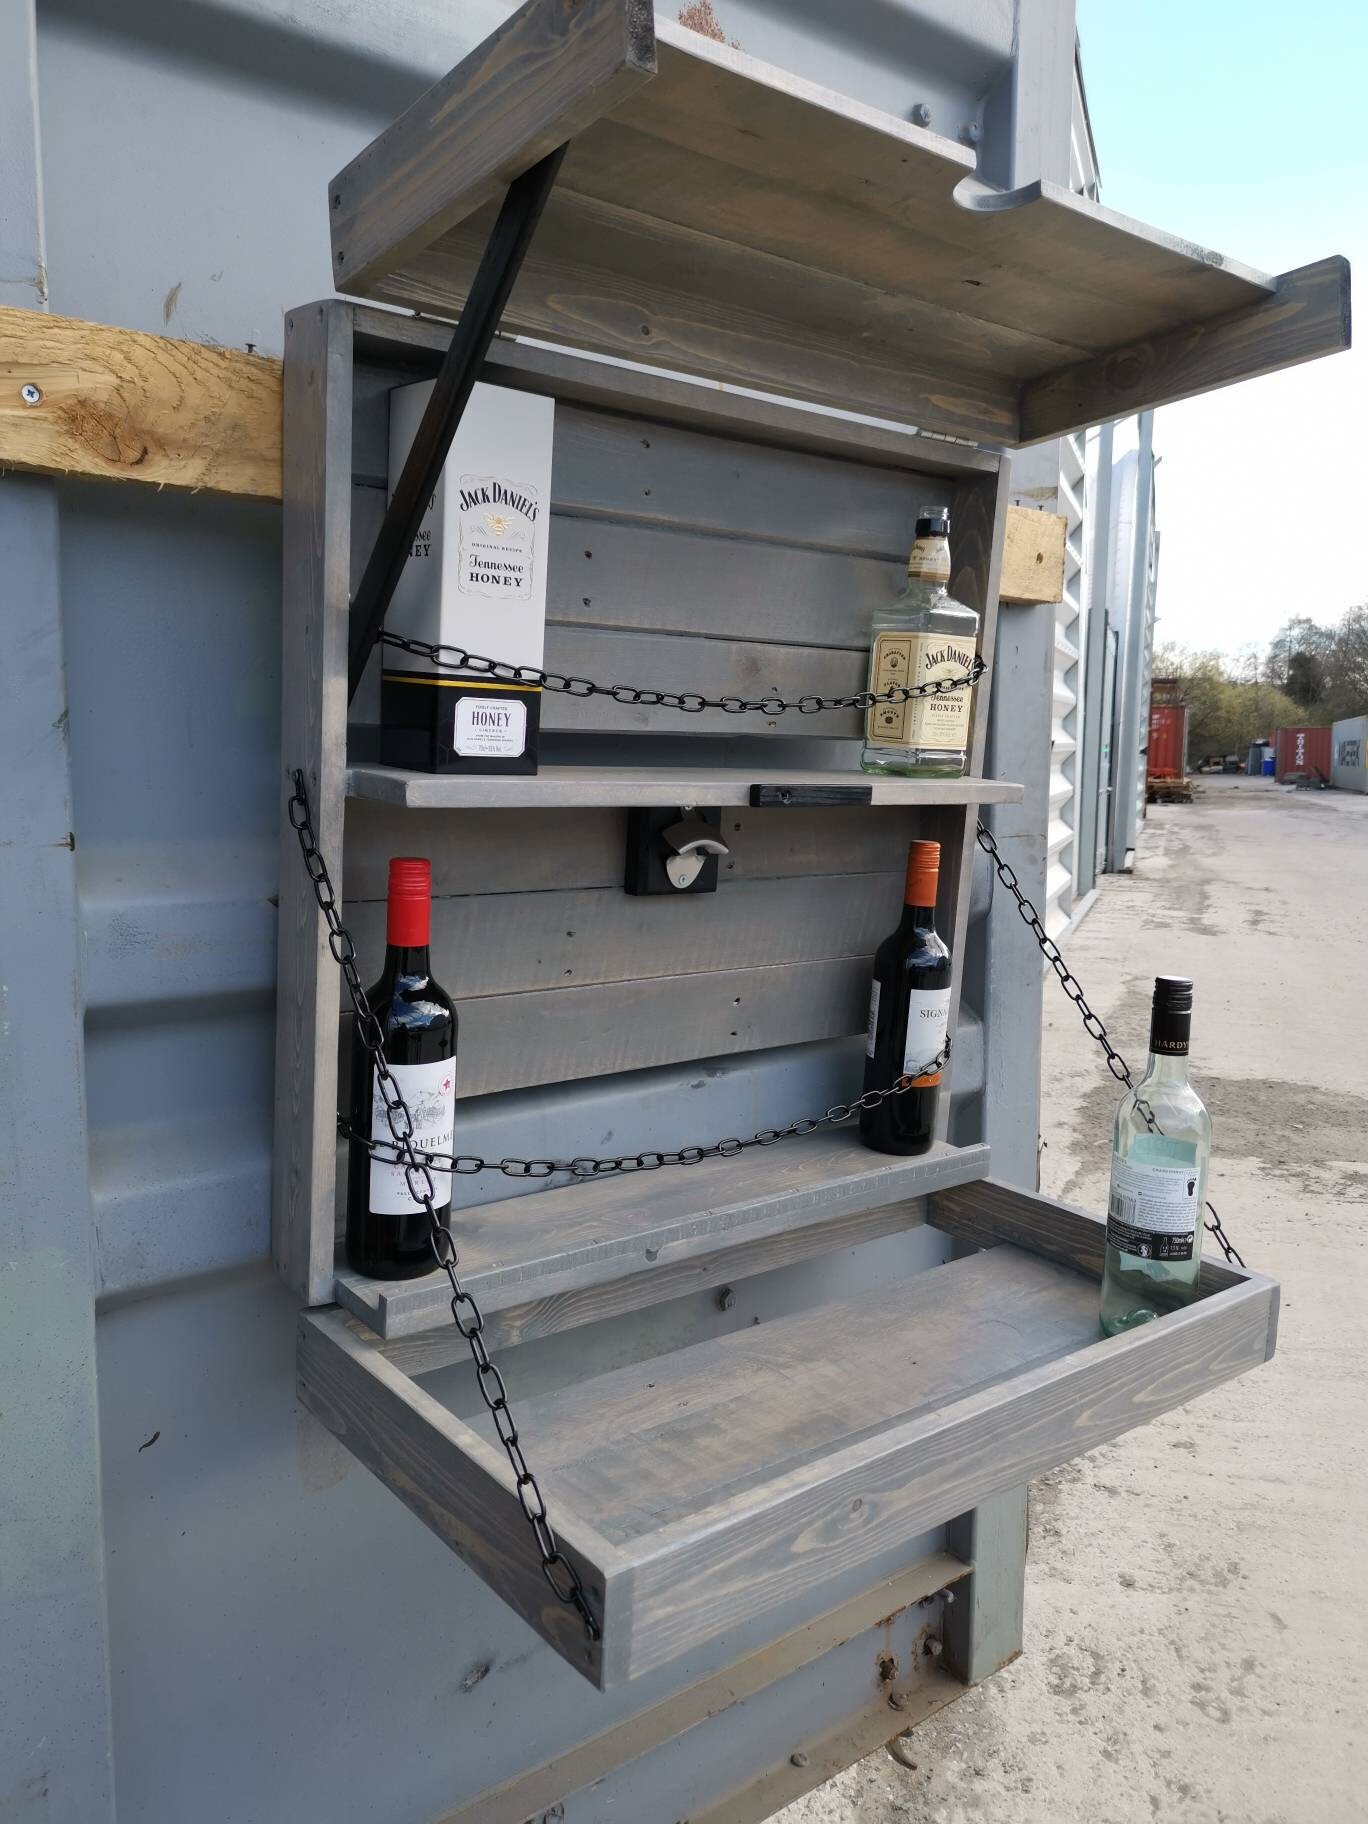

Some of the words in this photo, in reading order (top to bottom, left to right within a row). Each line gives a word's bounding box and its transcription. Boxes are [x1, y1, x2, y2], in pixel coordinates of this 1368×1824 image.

[460, 486, 490, 511] JACK
[493, 482, 539, 521] DANIEL'S
[469, 554, 524, 573] Tennessee
[469, 572, 522, 587] HONEY
[925, 650, 946, 670] JACK
[946, 645, 975, 674] DANIEL
[930, 703, 963, 713] HONEY
[472, 711, 511, 728] HONEY
